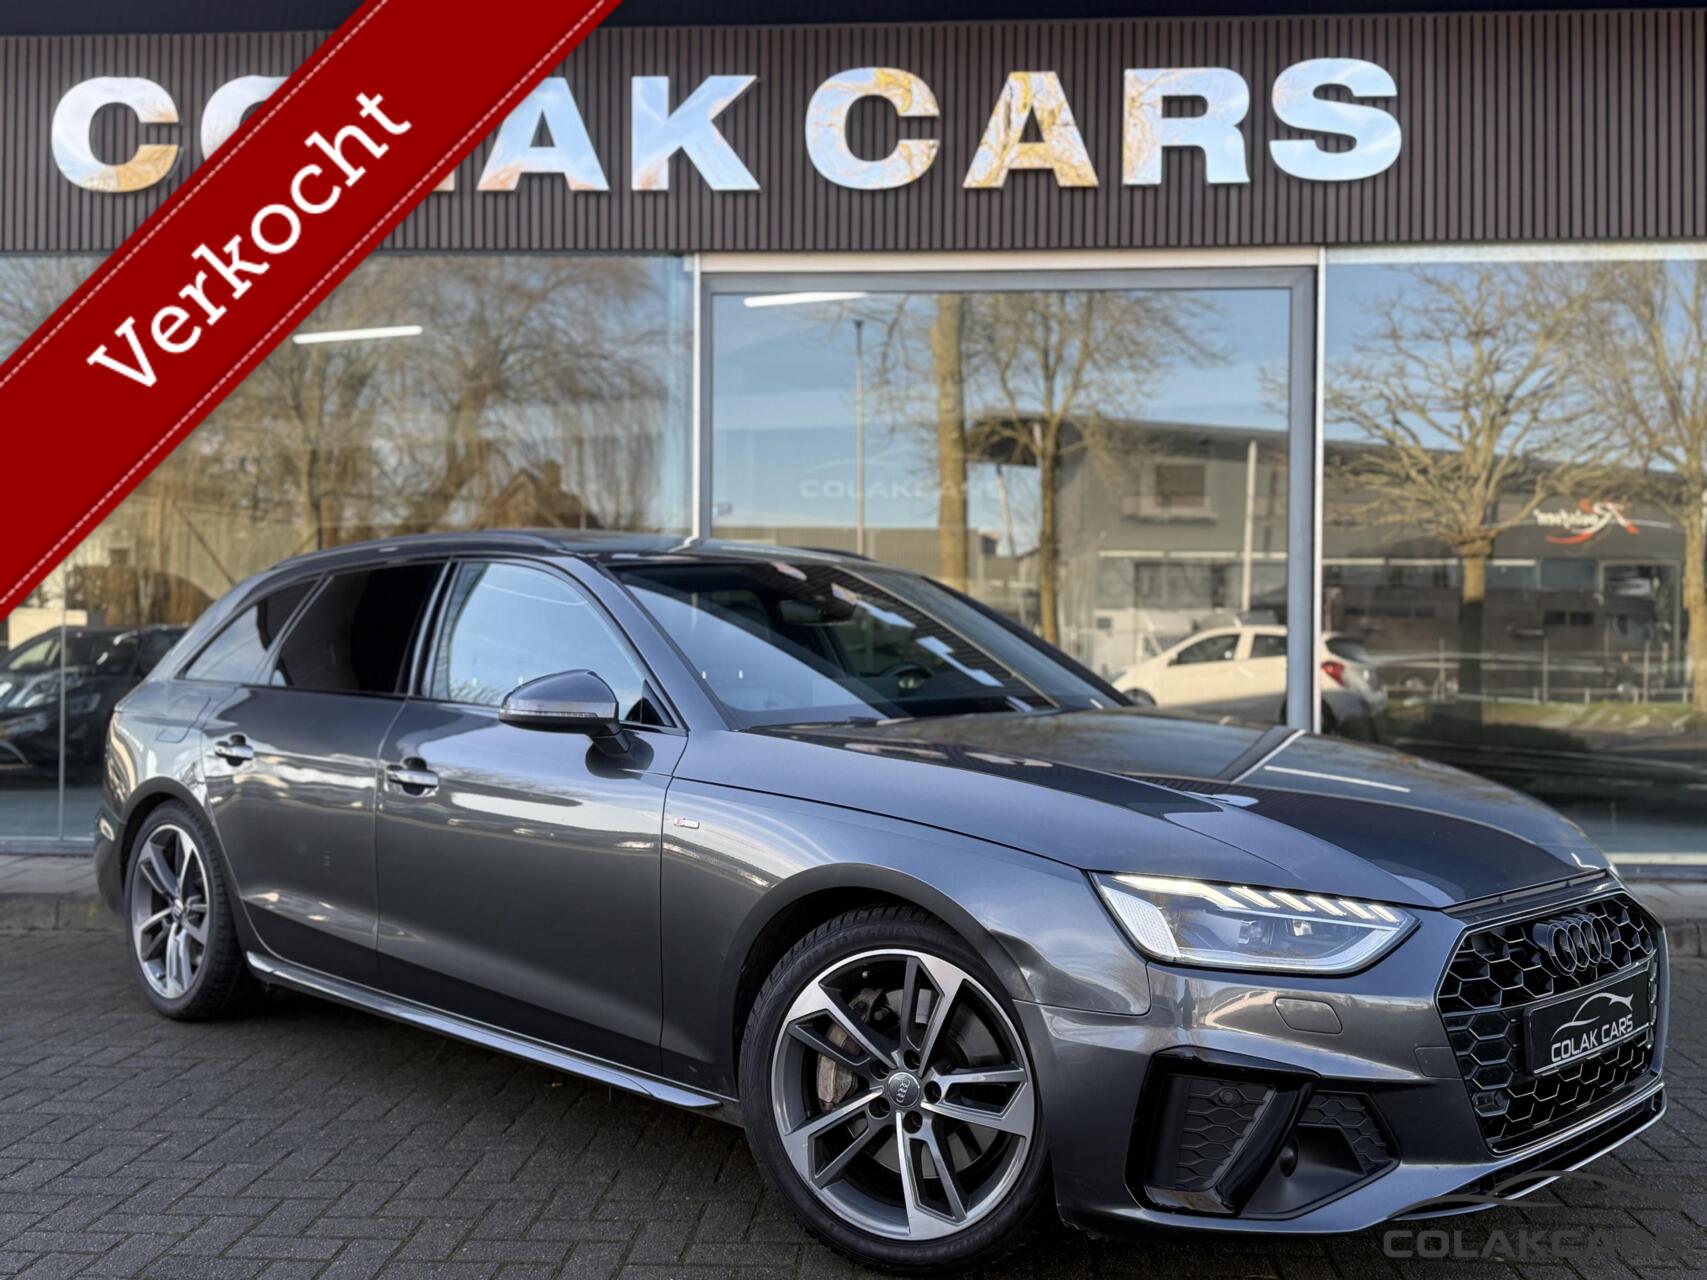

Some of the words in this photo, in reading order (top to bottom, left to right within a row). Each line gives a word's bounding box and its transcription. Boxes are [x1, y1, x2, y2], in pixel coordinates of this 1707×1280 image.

[51, 74, 762, 193] CAK
[805, 57, 1402, 191] CARS
[1551, 1028, 1599, 1063] COLAK
[1601, 1013, 1634, 1043] CARS
